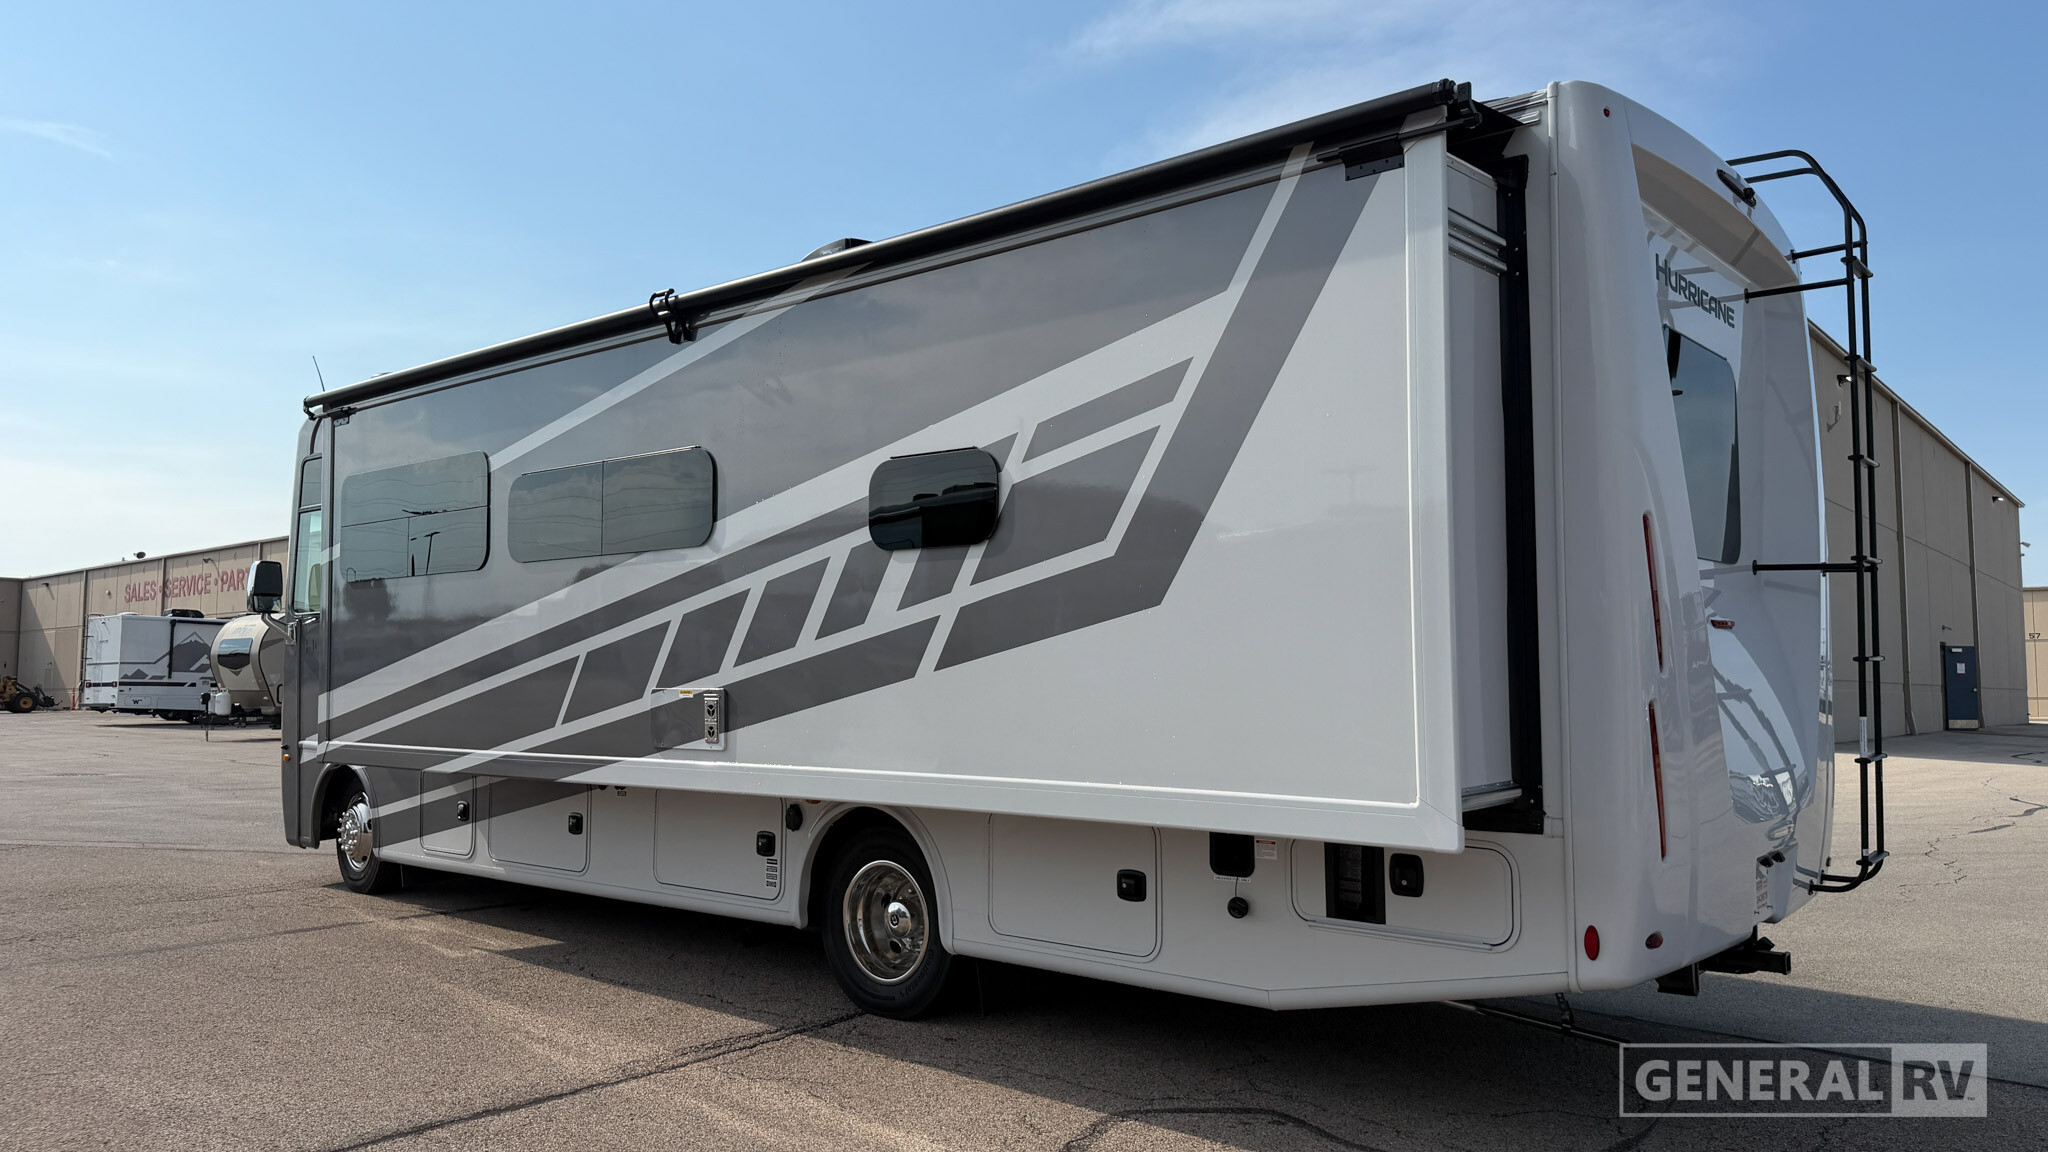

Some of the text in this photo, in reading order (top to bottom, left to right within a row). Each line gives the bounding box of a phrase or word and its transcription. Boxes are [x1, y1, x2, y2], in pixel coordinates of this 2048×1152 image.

[1655, 253, 1735, 329] HURRICANE
[124, 580, 157, 603] SALES
[164, 573, 211, 599] SERVICE
[2029, 632, 2041, 640] 57
